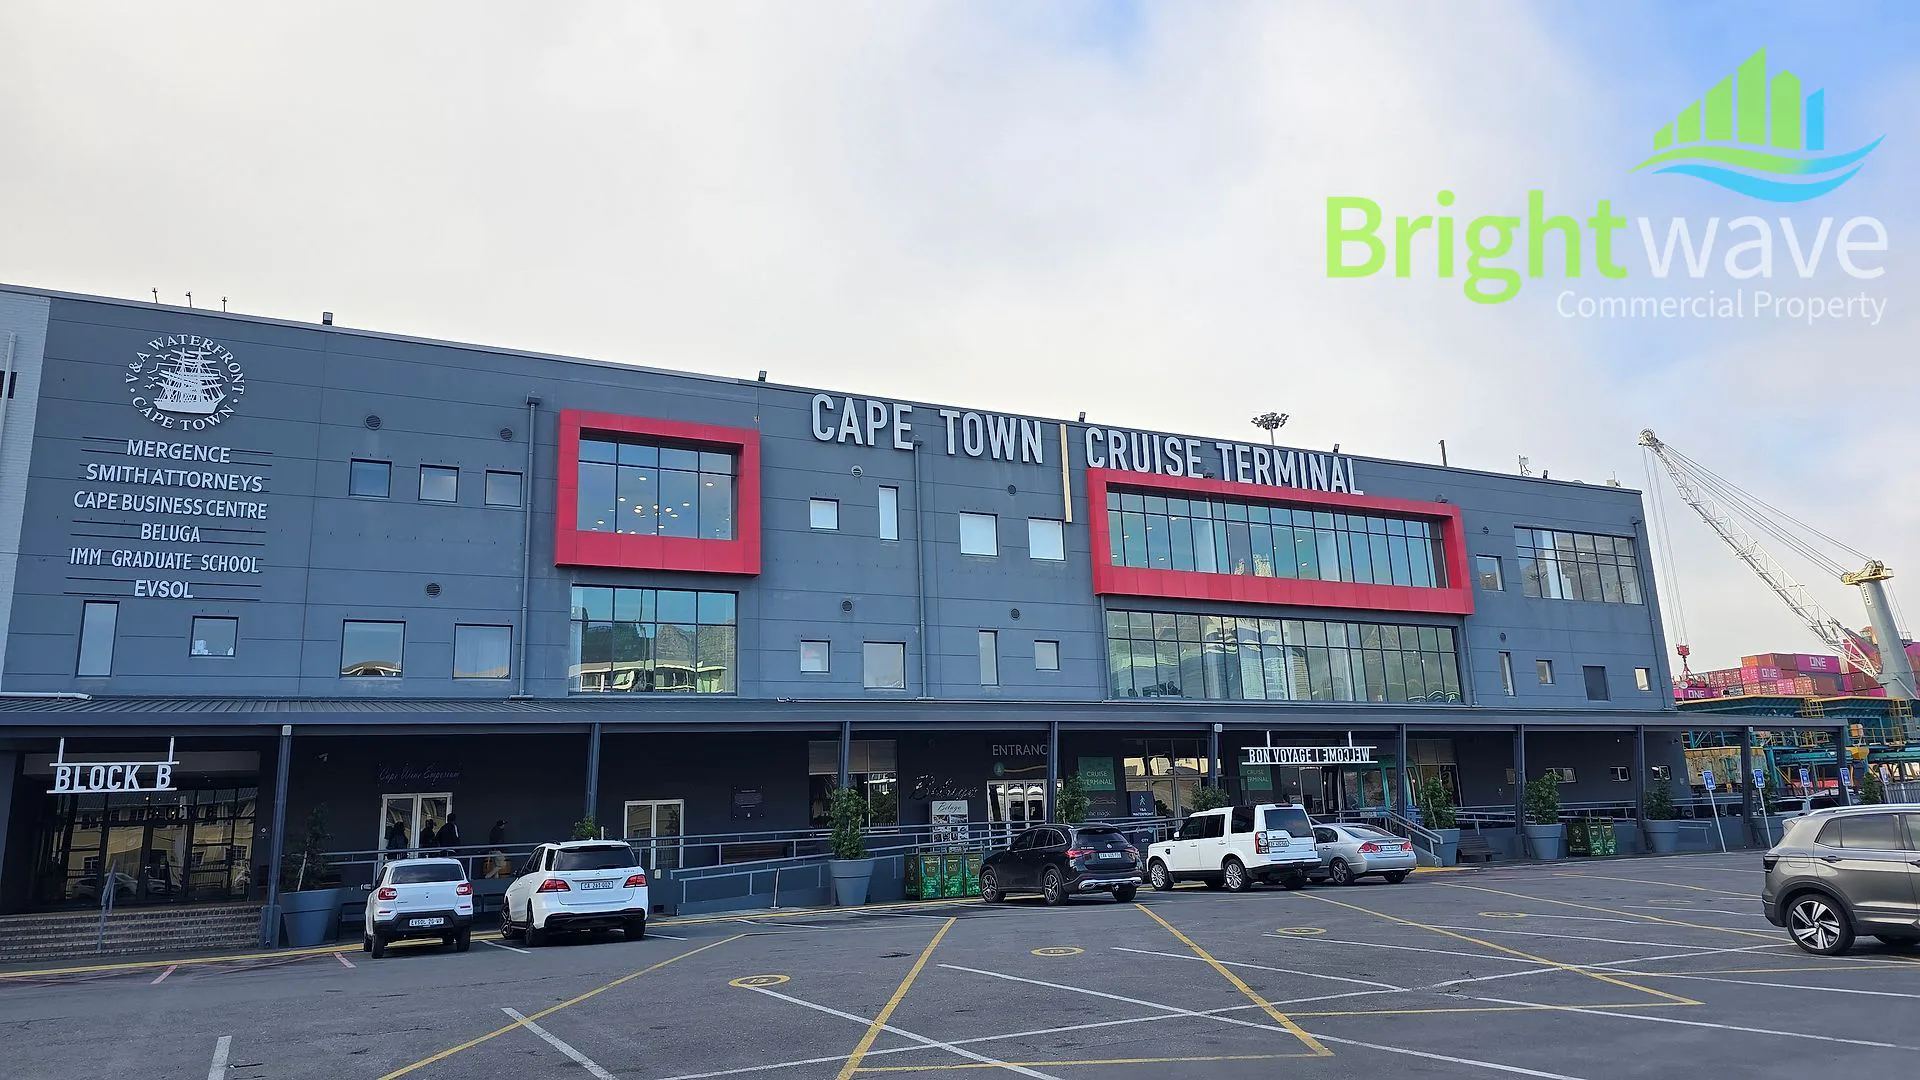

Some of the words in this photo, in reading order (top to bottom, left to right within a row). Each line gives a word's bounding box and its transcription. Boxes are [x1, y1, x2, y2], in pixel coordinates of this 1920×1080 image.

[125, 351, 151, 383] V&A
[148, 334, 245, 395] WATERFRONT
[132, 397, 175, 429] CAPE
[180, 404, 235, 431] TOWN
[811, 393, 914, 451] CAPE
[938, 408, 1044, 464] TOWN
[126, 439, 231, 464] MERGENCE
[1085, 426, 1203, 479] CRUISE
[1215, 441, 1364, 496] TERMINAL
[86, 463, 148, 485] SMITH
[151, 469, 263, 493] ATTORNEYS
[74, 490, 118, 511] CAPE
[121, 494, 203, 516] BUSINESS
[205, 500, 268, 520] CENTRE
[140, 523, 201, 543] BELUGA
[70, 547, 101, 566] IMM
[111, 549, 193, 570] GRADUATE
[200, 554, 260, 574] SCHOOL
[134, 579, 194, 599] EVSOL
[1761, 668, 1778, 678] ONE
[1809, 656, 1827, 667] ONE
[1688, 690, 1705, 698] ONE
[992, 744, 1048, 756] ENTRANC
[1249, 748, 1269, 763] BON
[1274, 748, 1311, 763] VOYAGE
[55, 765, 141, 791] BLOCK
[156, 764, 172, 790] B
